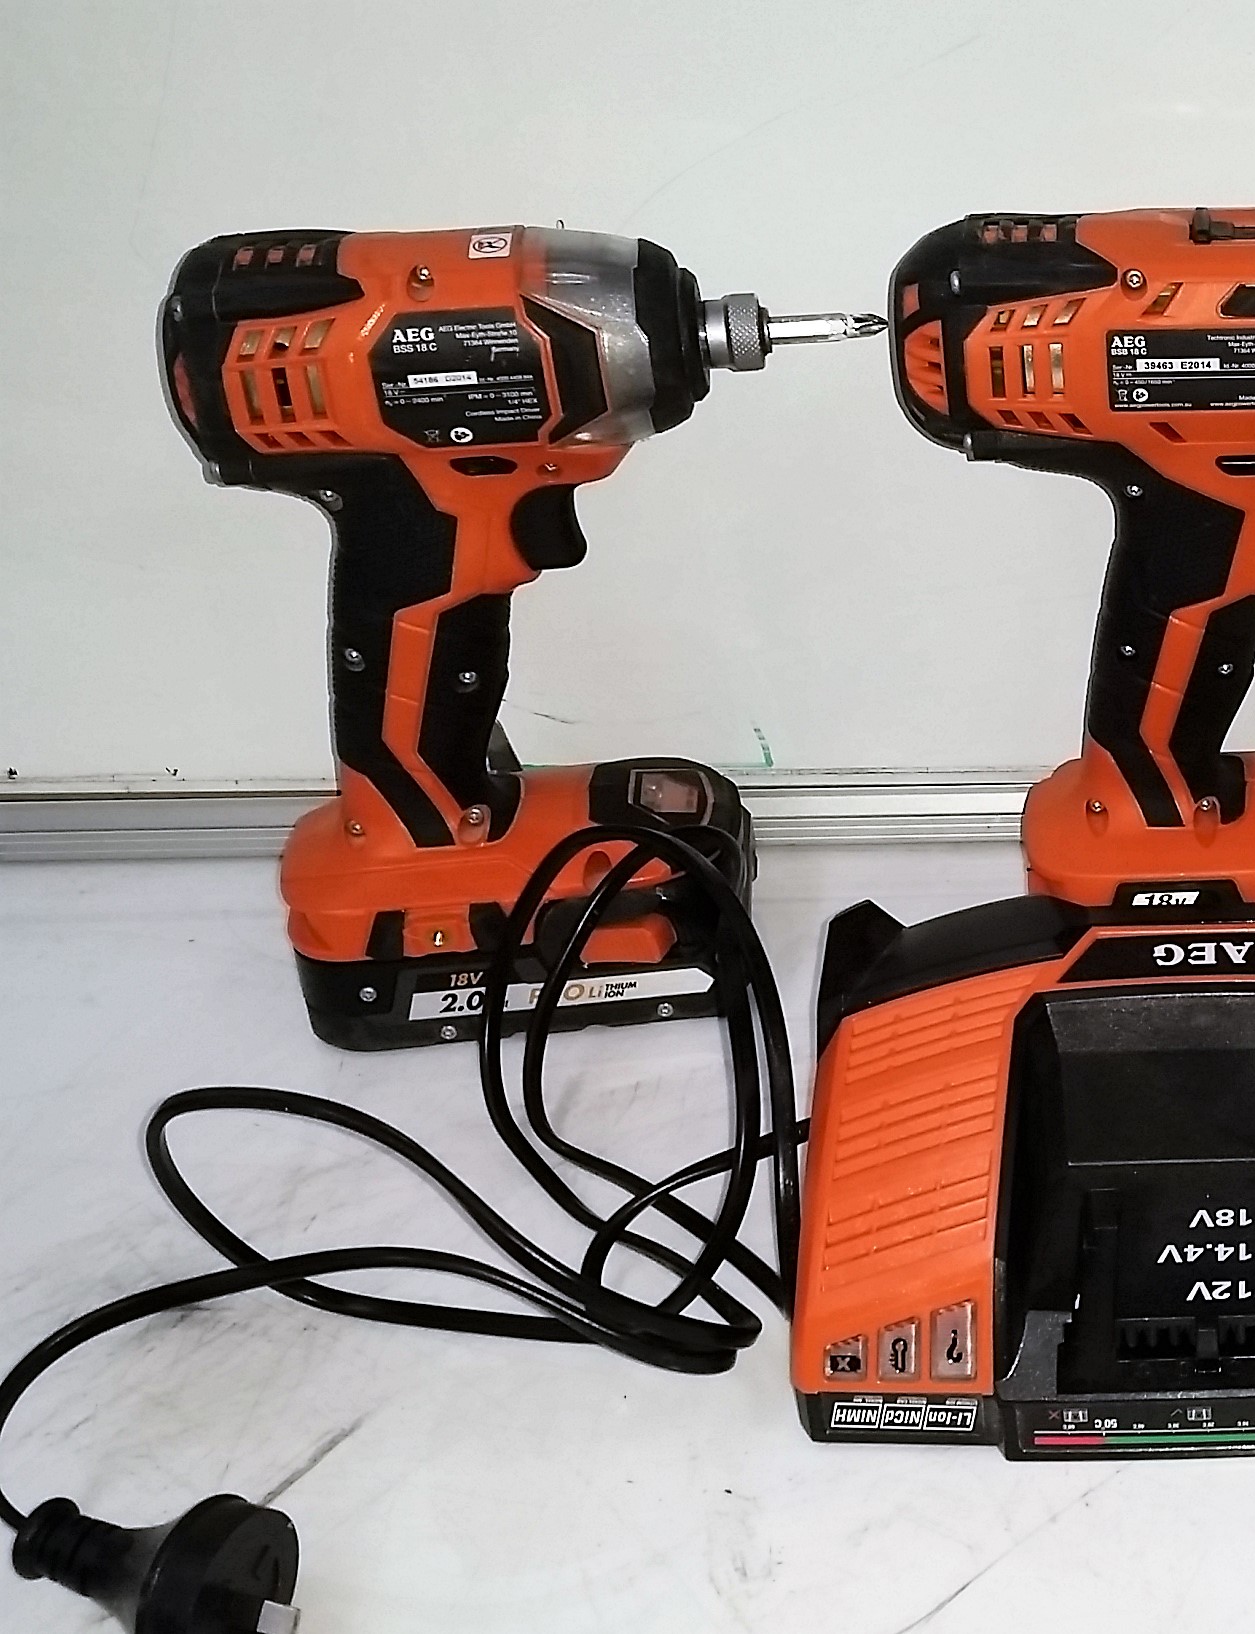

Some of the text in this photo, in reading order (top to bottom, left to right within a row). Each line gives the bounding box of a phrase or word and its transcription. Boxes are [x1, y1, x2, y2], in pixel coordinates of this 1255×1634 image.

[495, 321, 516, 329] GmbH
[392, 327, 435, 343] AEG
[1111, 335, 1146, 348] AEG
[393, 342, 438, 354] BSS 18 C
[1111, 348, 1148, 356] BSB 18 C
[1144, 361, 1174, 370] 39463
[1180, 360, 1212, 370] E2014
[1153, 941, 1255, 966] AEG
[450, 971, 484, 987] 18V
[1189, 1208, 1253, 1228] 18V
[1157, 1243, 1252, 1263] 14.4V
[1186, 1280, 1252, 1301] 12V
